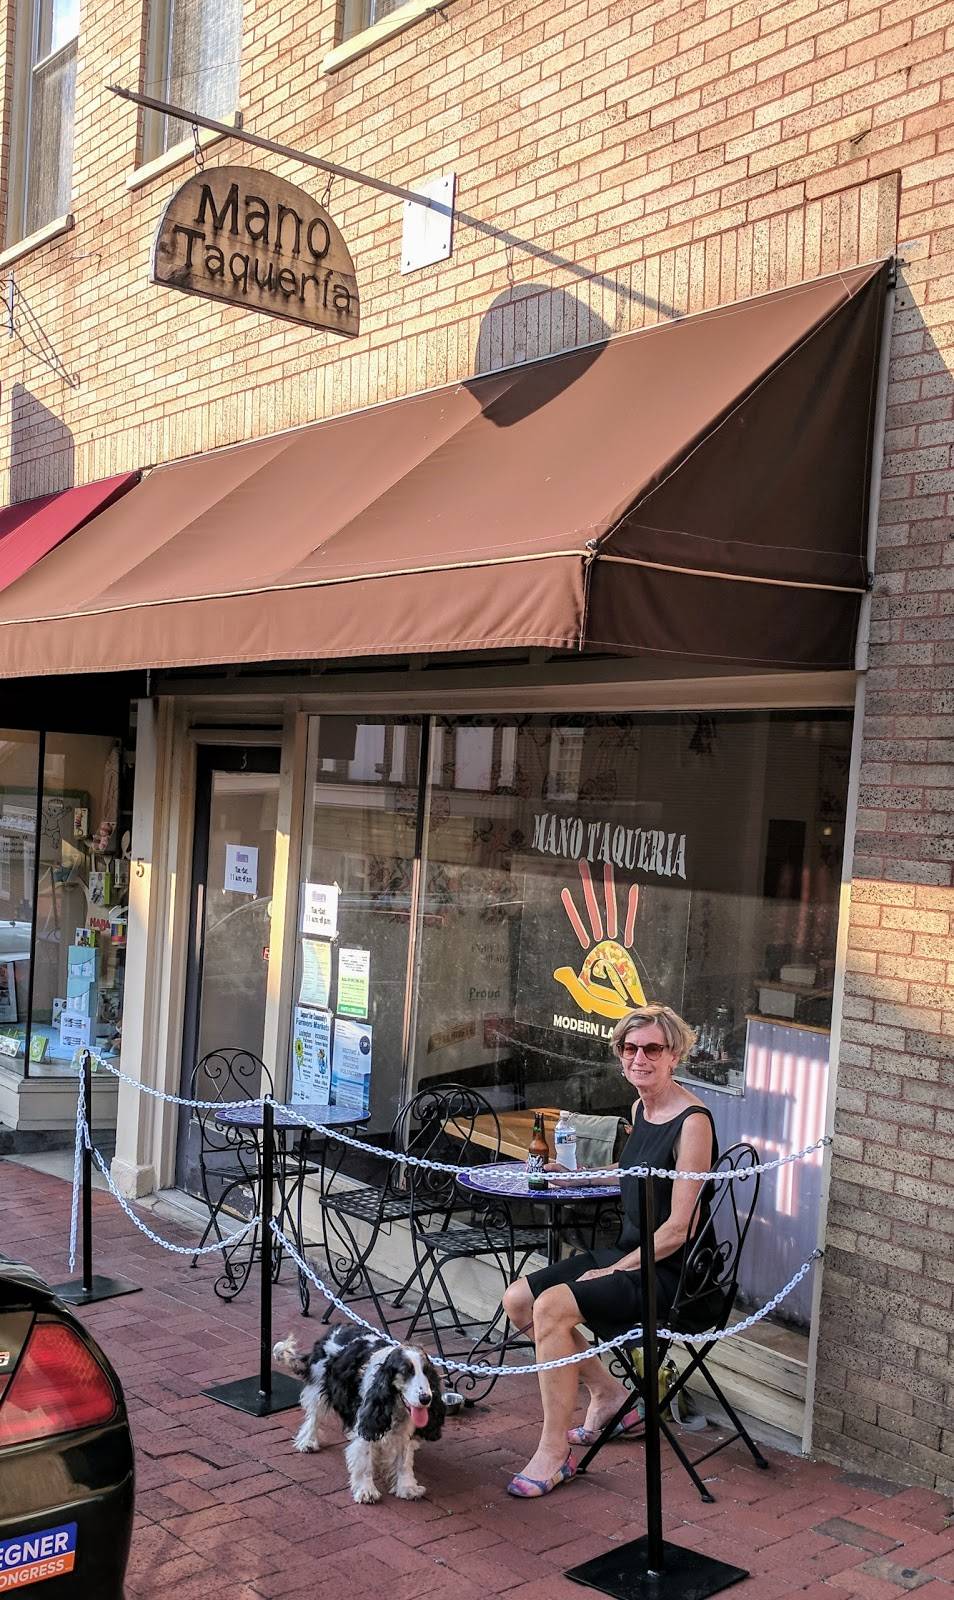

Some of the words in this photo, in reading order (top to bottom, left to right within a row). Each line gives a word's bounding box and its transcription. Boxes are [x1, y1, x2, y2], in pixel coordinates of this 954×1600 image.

[194, 183, 331, 259] Mano
[136, 857, 145, 878] 5
[531, 813, 584, 860] MANO
[587, 821, 687, 880] TAQUERIA
[553, 1014, 600, 1036] MODERN
